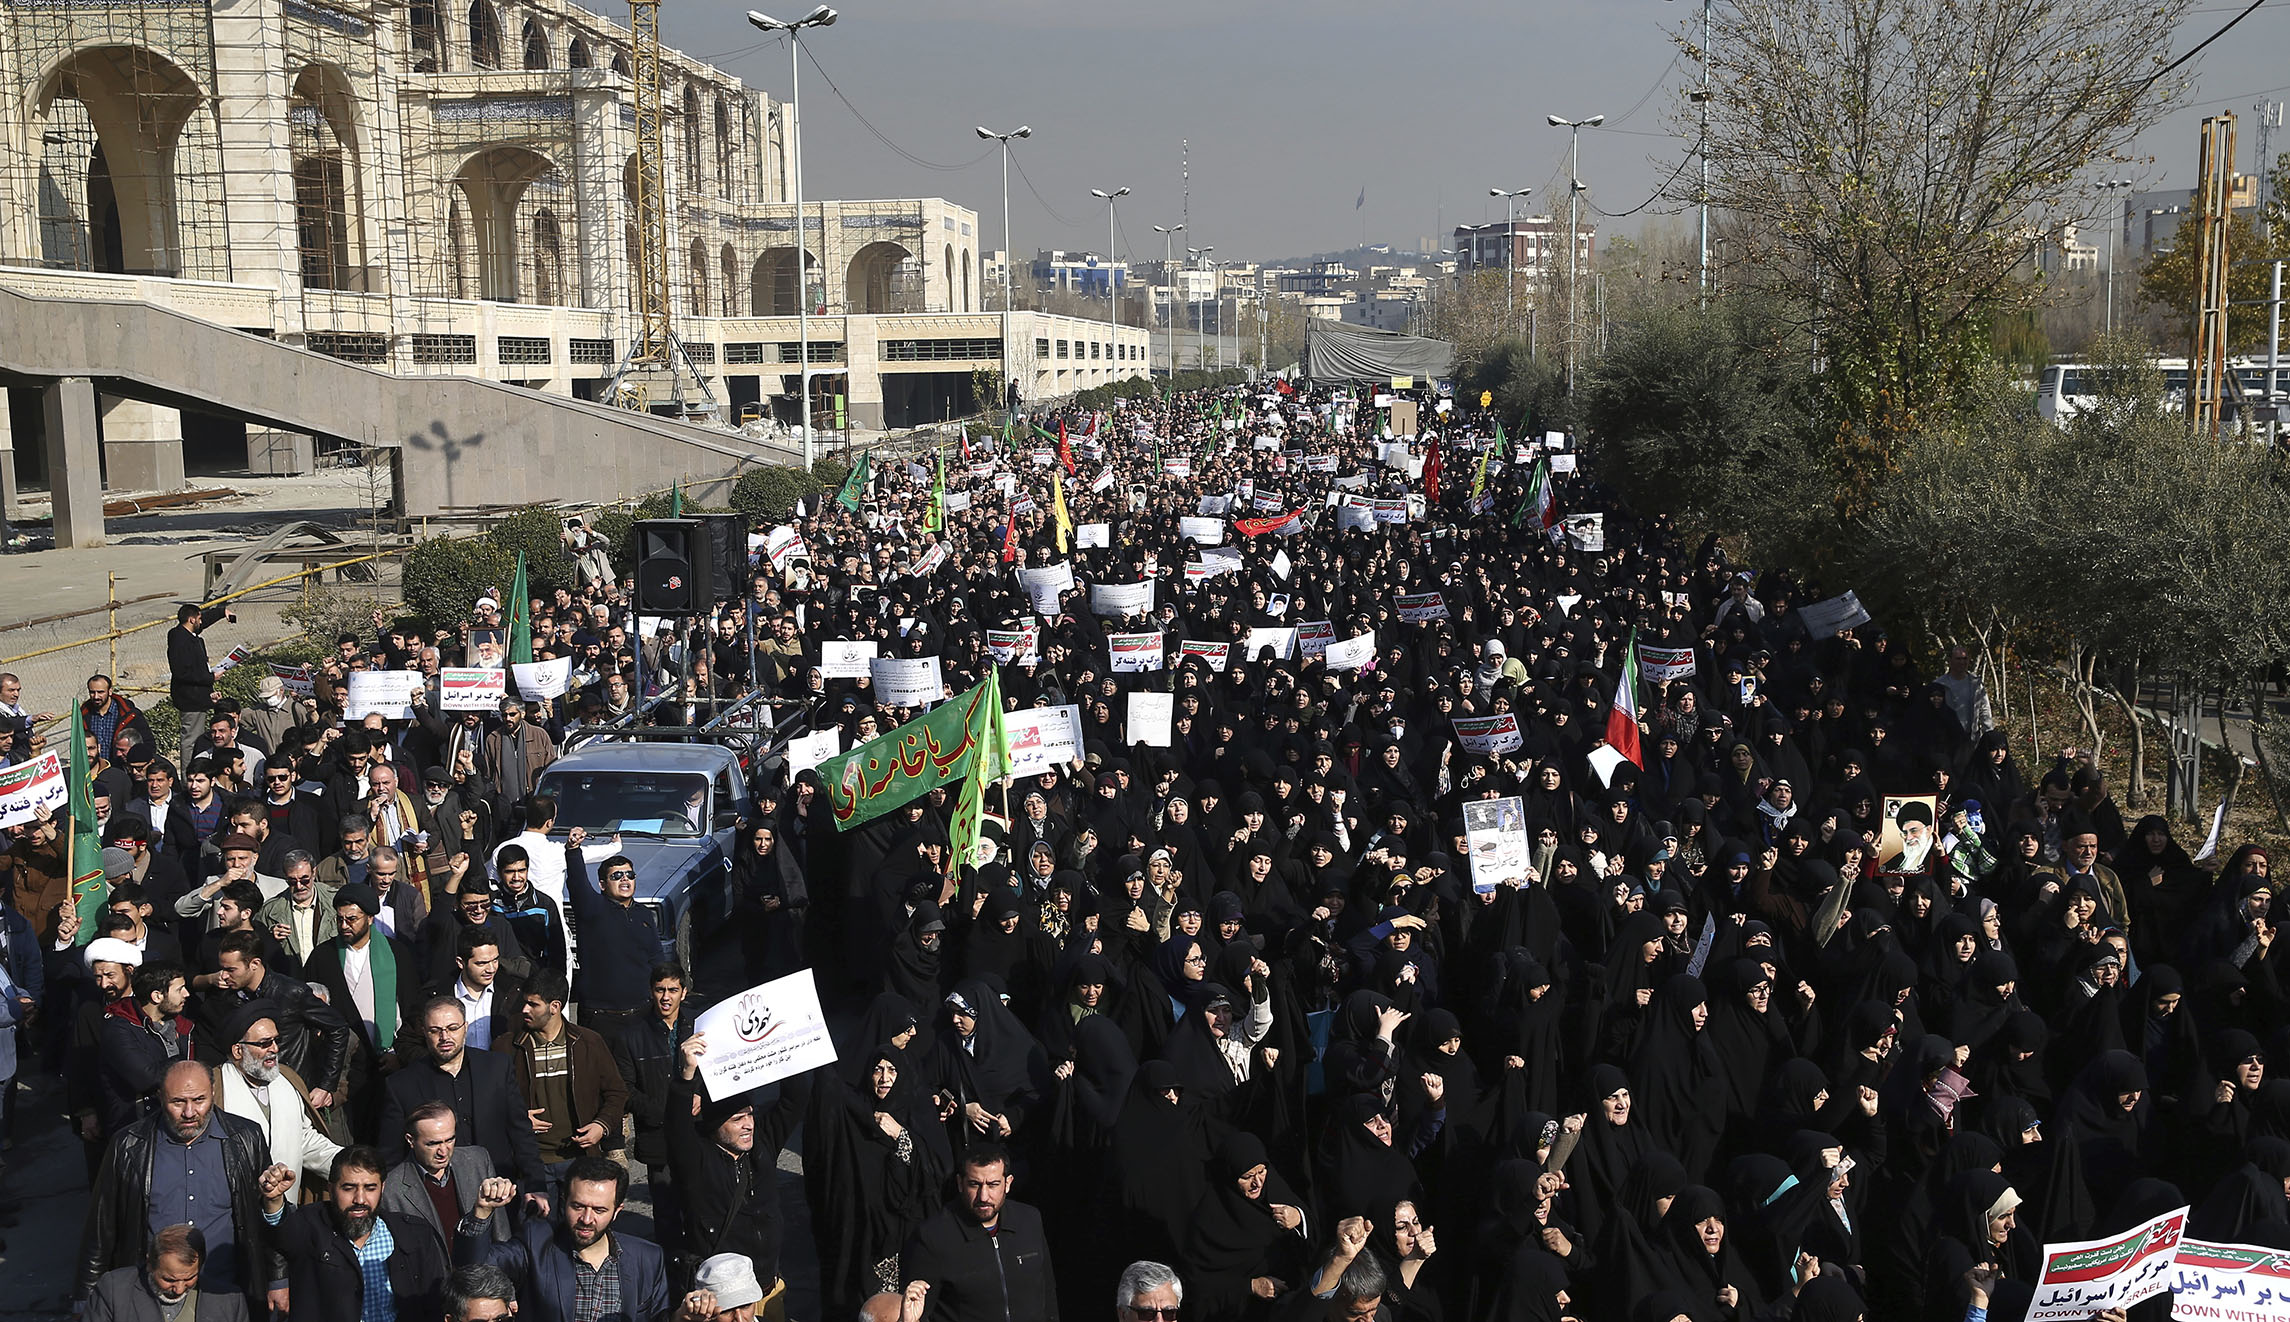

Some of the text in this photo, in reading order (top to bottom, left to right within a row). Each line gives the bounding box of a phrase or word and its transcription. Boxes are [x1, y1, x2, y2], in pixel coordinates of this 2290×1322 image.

[2038, 1283, 2115, 1308] اسرائیل
[2116, 1279, 2132, 1301] بر
[2169, 1271, 2246, 1300] اسرائیل
[2254, 1288, 2272, 1306] بر
[2033, 1309, 2082, 1320] DOWN
[2225, 1308, 2267, 1322] WITH
